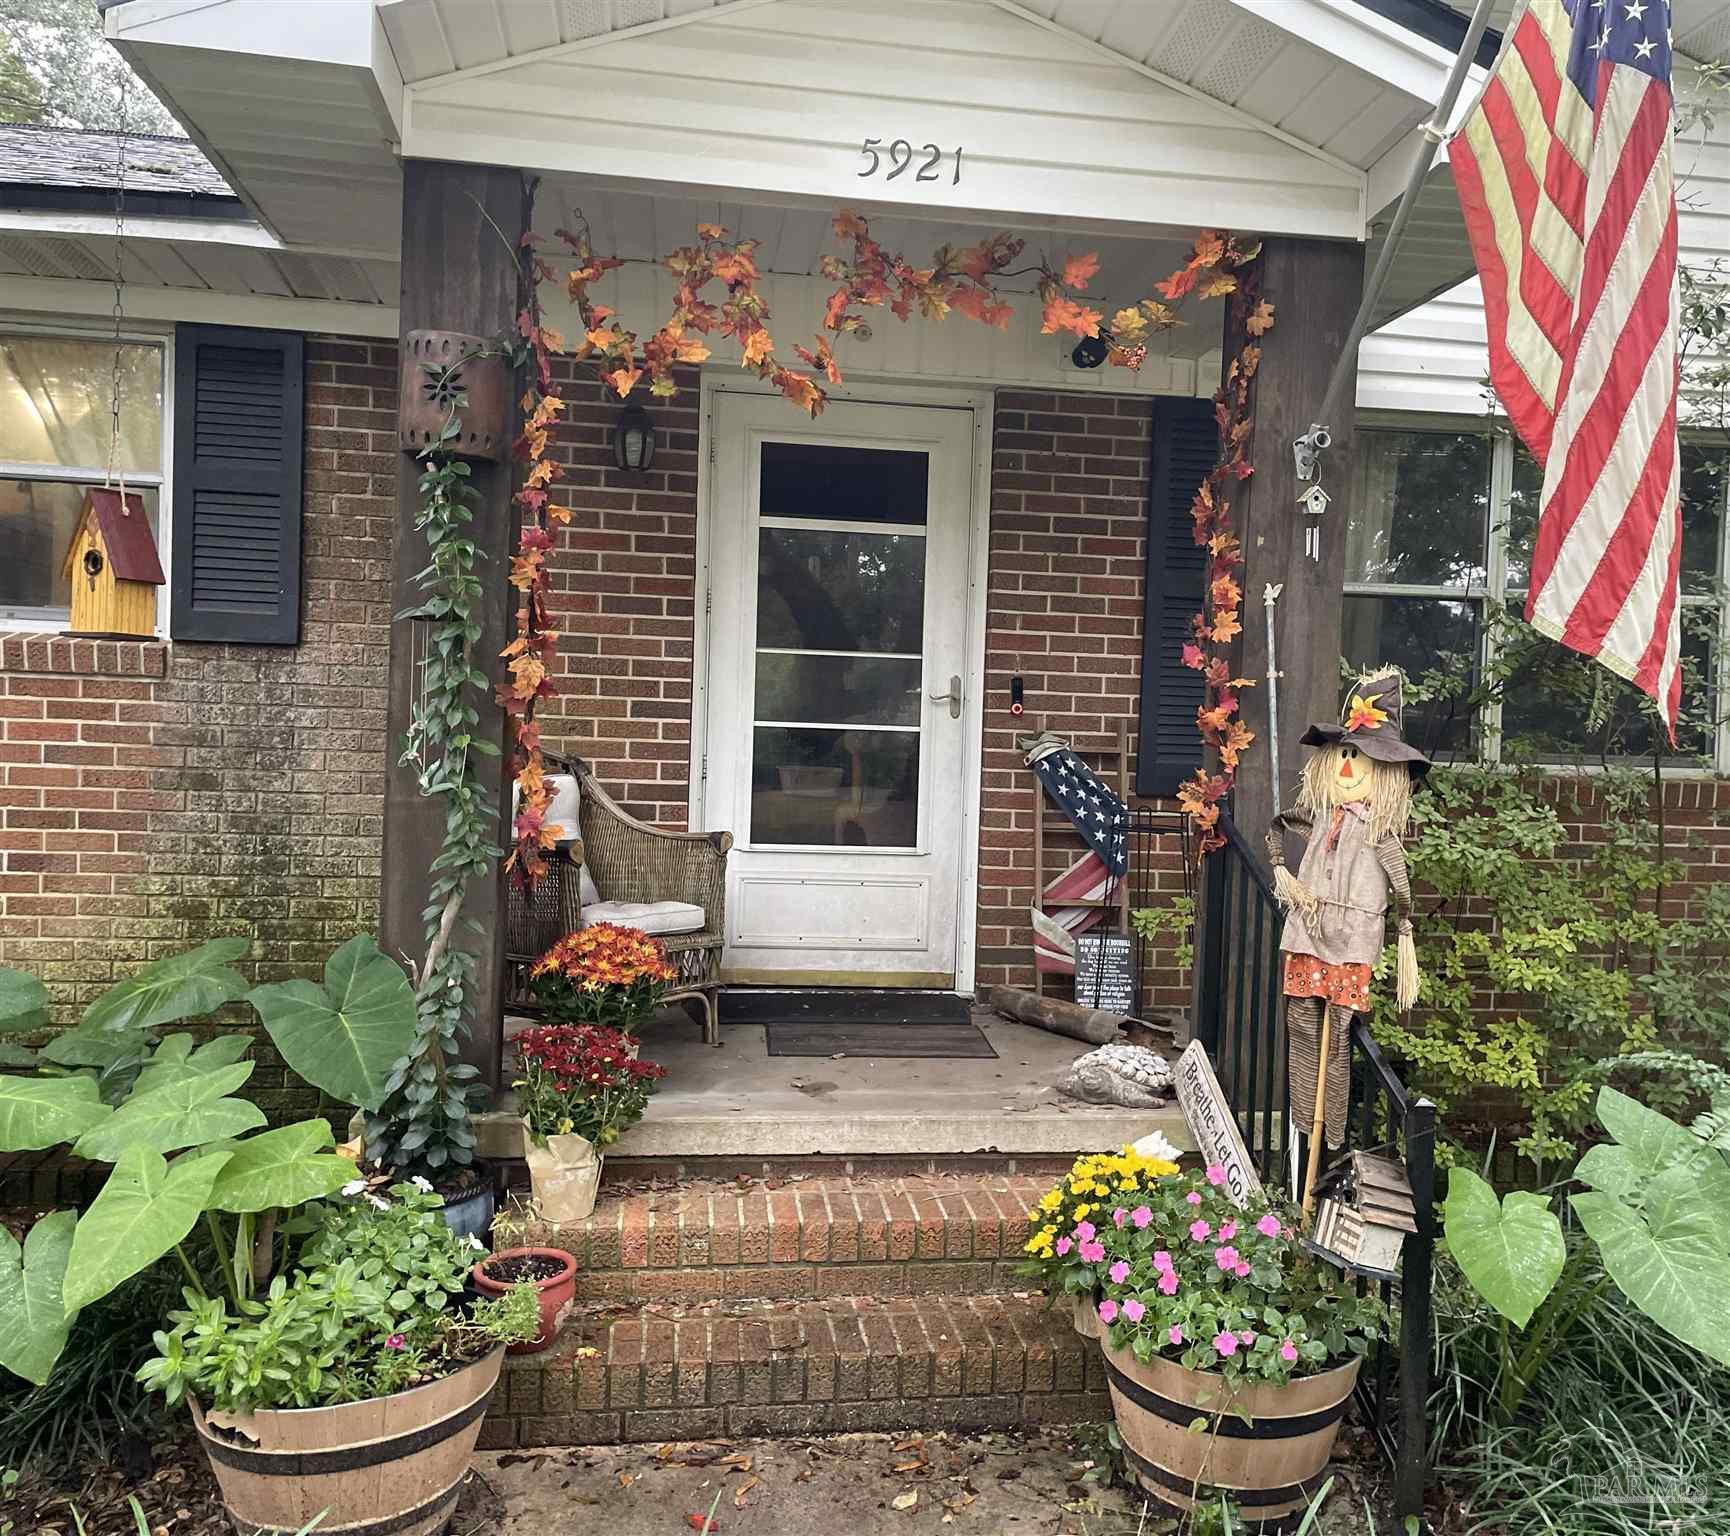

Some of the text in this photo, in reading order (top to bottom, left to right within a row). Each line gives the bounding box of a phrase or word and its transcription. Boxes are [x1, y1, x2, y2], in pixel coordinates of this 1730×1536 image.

[857, 138, 962, 185] 5921
[1214, 1131, 1231, 1167] Let
[1227, 1163, 1242, 1197] Go
